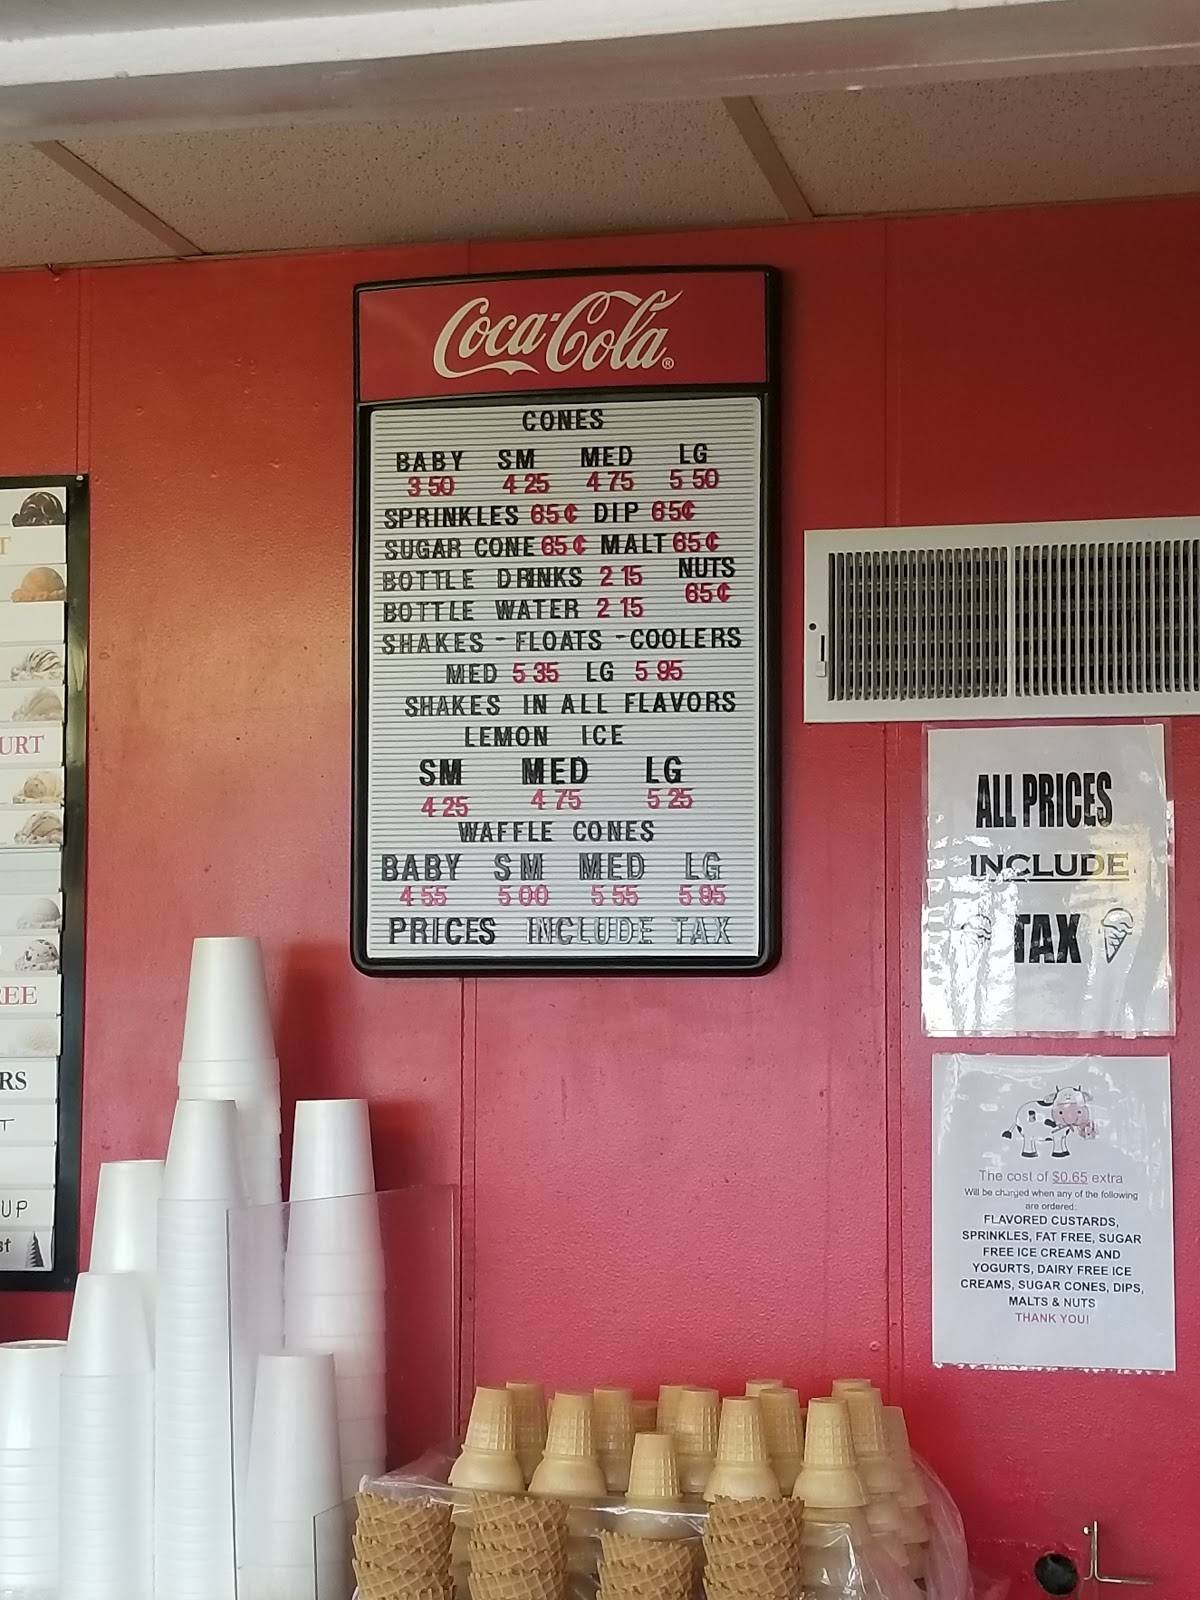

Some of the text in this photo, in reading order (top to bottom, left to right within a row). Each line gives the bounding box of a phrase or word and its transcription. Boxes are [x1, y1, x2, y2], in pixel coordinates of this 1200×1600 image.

[433, 290, 683, 379] Coca-Cola
[523, 409, 603, 431] CONES
[396, 443, 708, 472] BABY SM MED LG
[384, 506, 518, 528] SPRINKLES
[594, 502, 638, 522] DIP
[385, 538, 461, 559] SUGAR
[474, 537, 535, 557] CONE
[601, 533, 667, 554] MALT
[382, 570, 474, 591] BOTTLE
[498, 567, 583, 589] DRINKS
[679, 558, 735, 578] NUTS
[382, 601, 474, 622] BOTTLE
[496, 599, 579, 620] WATER
[382, 632, 483, 654] SHAKES
[516, 630, 602, 651] FLOATS
[446, 664, 497, 684] MED
[587, 662, 613, 682] LG
[405, 692, 735, 717] SHAKES IN ALL FLAVORS
[465, 725, 623, 747] LEMON ICE
[419, 756, 682, 786] SM MED LG
[976, 772, 1112, 828] ALL PRICES
[458, 820, 654, 842] WAFFLE CONES
[381, 852, 721, 881] BABY SM MED LG
[970, 853, 1129, 882] INCLUDE
[389, 916, 733, 944] PRICES INCLUDE TAX
[1014, 914, 1081, 963] TAX
[979, 1170, 1123, 1184] The cost of $0.65 extra
[965, 1188, 979, 1196] Will
[995, 1189, 1029, 1198] charged
[1100, 1191, 1138, 1200] following
[984, 1215, 1119, 1228] FLAVORED CUSTARDS,
[962, 1231, 1141, 1243] SPRINKLES, FAT FREE, SUGAR
[983, 1247, 1120, 1259] FREE ICE CREAMS AND
[973, 1263, 1131, 1276] YOGURTS, DAIRY FREE ICE
[961, 1279, 1144, 1294] CREAMS, SUGAR CONES, DIPS,
[1009, 1296, 1095, 1308] MALTS & NUTS
[1016, 1313, 1089, 1324] THANK YOU!
